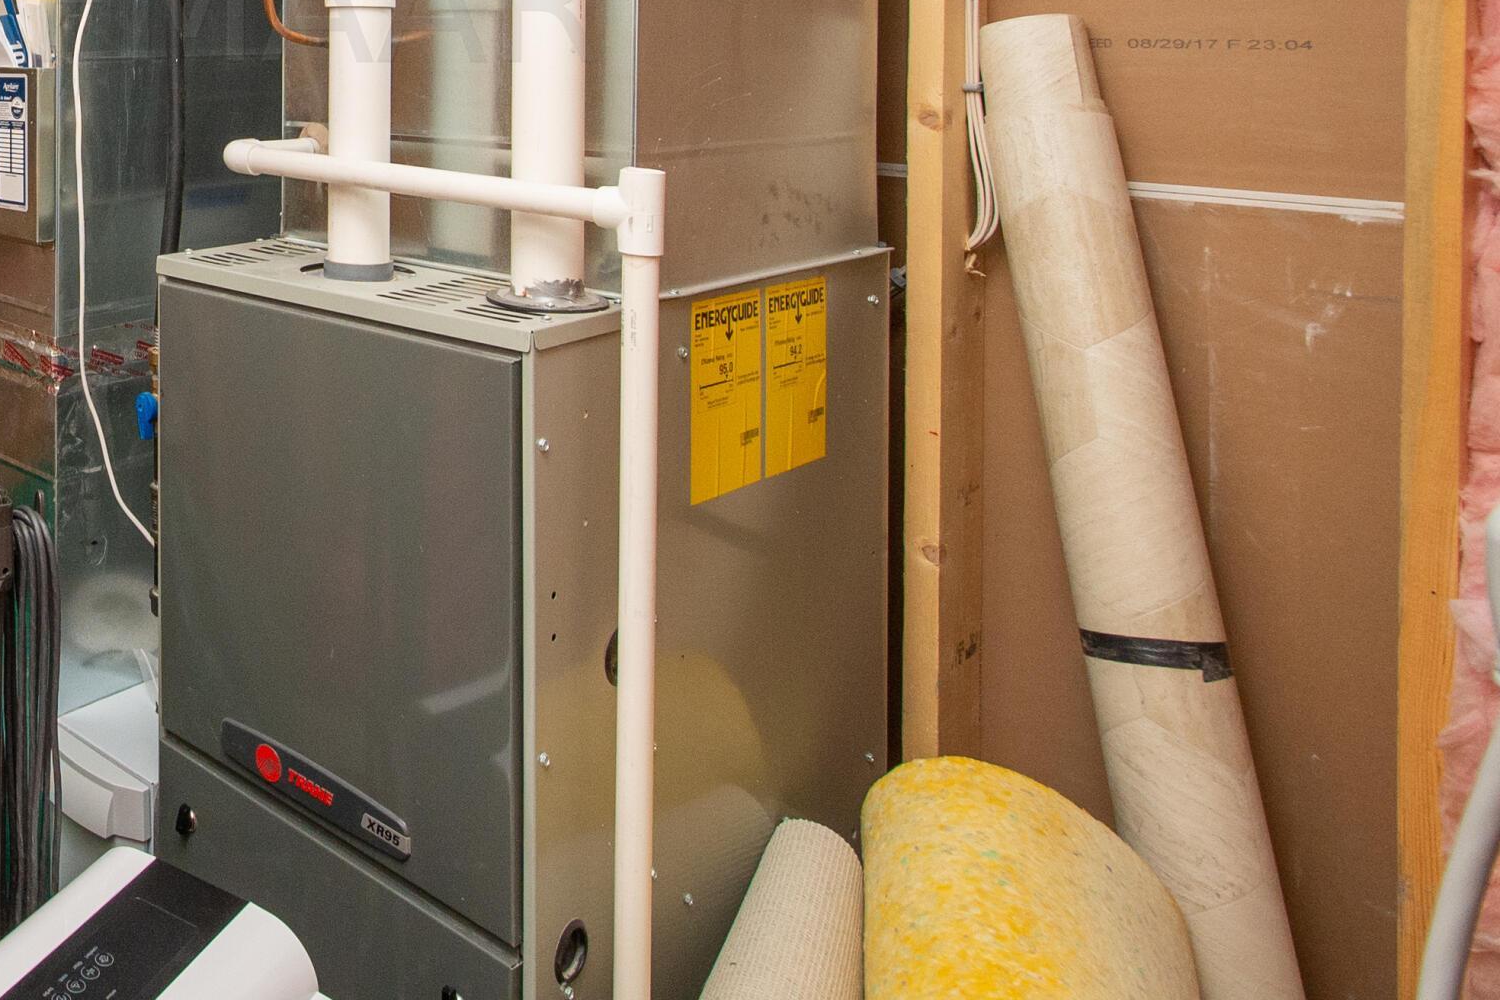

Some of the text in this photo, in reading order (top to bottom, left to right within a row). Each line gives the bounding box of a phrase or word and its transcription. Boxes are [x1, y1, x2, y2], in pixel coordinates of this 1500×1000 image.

[1127, 38, 1218, 49] 08/29/17
[1227, 39, 1241, 49] F
[1248, 39, 1313, 50] 23:04
[288, 767, 334, 807] TRANE
[367, 818, 400, 847] XR95
